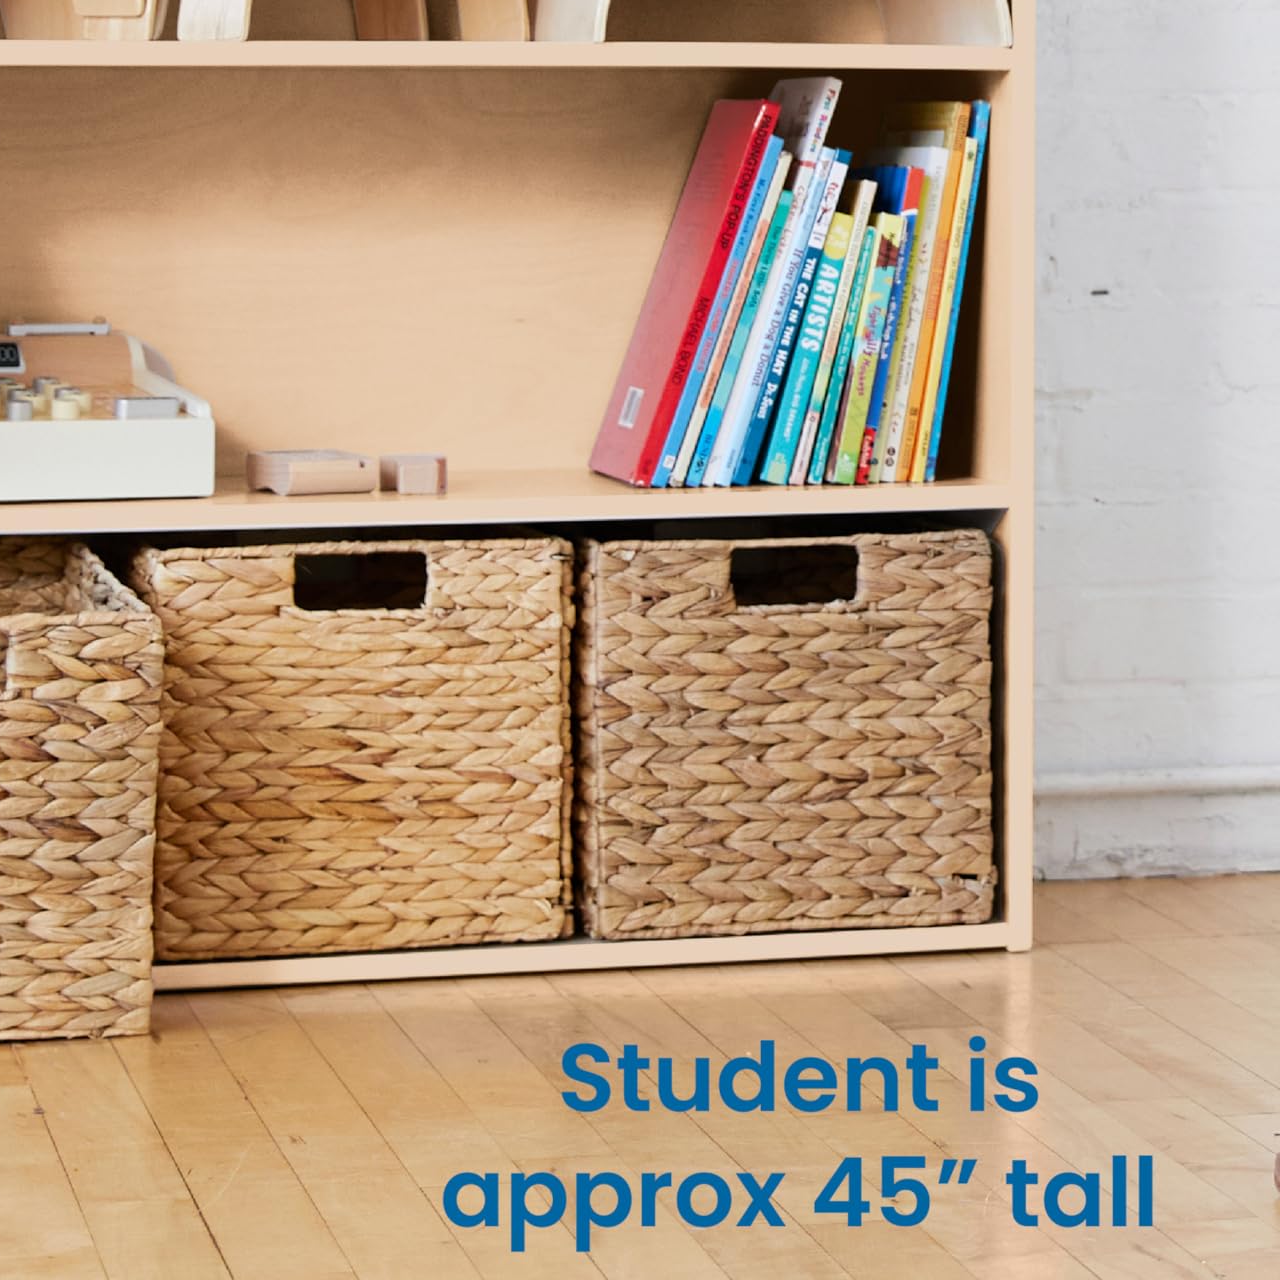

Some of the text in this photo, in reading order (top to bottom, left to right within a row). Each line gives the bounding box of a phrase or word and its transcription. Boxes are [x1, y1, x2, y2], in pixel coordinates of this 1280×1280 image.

[822, 87, 837, 111] First
[733, 113, 773, 202] PADDINGTON'S
[717, 203, 742, 250] POP-UP
[800, 255, 817, 281] THE
[792, 281, 809, 308] CAT
[798, 261, 841, 353] ARTISTS
[682, 295, 710, 350] MICHAEL
[750, 247, 803, 388] If You Give a Dog a Donut
[786, 307, 800, 324] IN
[866, 304, 882, 328] Eight
[779, 324, 795, 347] THE
[670, 348, 692, 386] BOND
[769, 347, 789, 377] HAT
[854, 357, 872, 397] Monkeys
